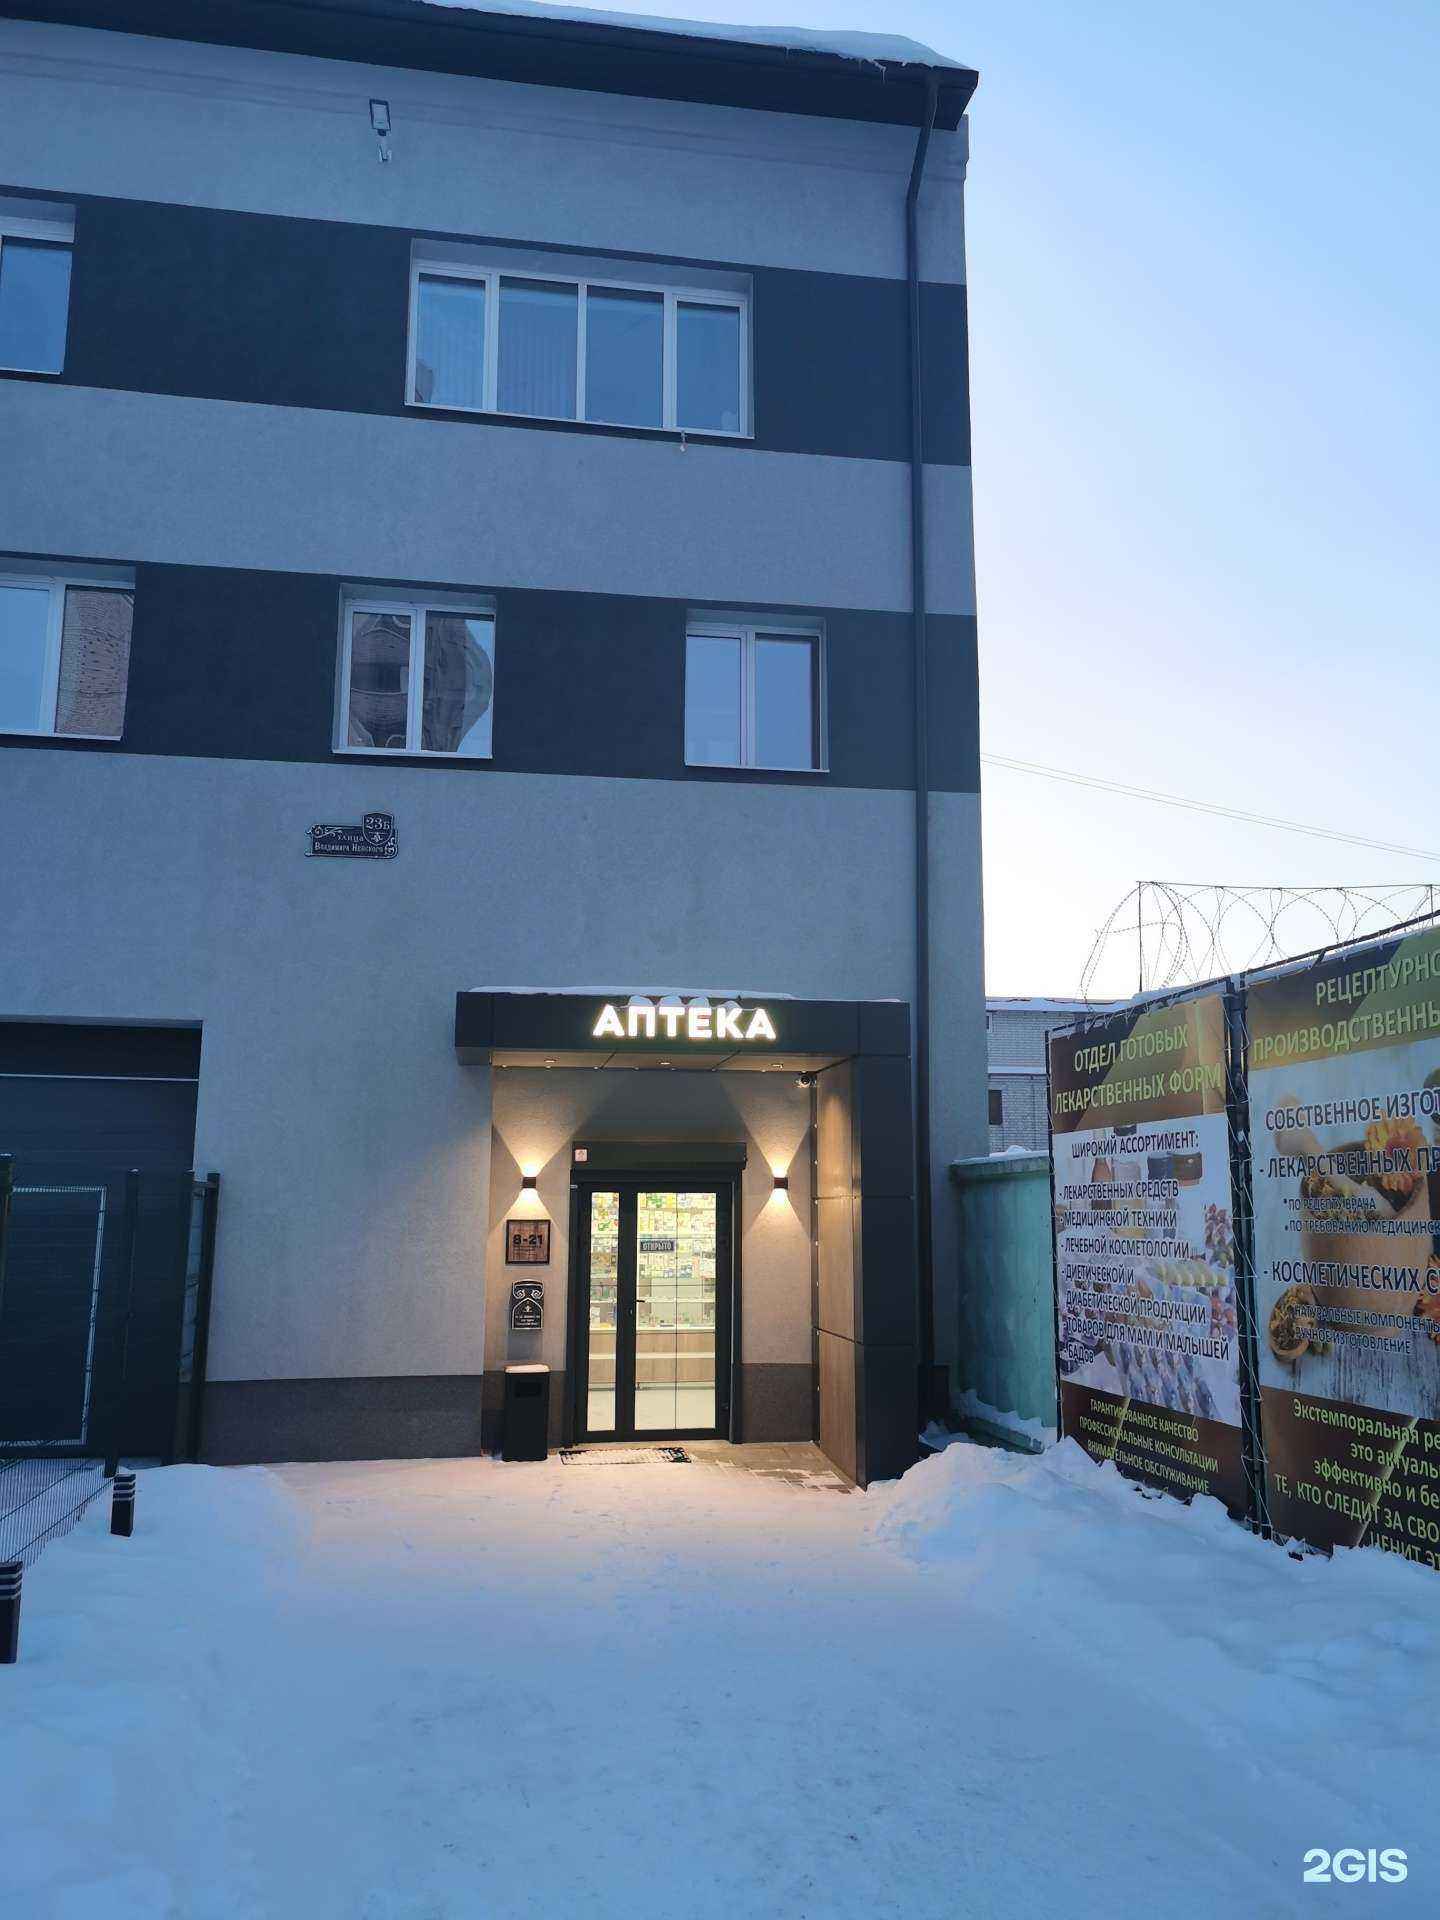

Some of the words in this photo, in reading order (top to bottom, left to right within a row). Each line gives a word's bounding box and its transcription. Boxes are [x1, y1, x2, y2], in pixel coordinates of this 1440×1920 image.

[592, 1004, 776, 1039] АПТЕКА
[1074, 1043, 1116, 1074] ОТДЕЛ
[1120, 1024, 1188, 1062] ГОТОВЫХ
[1055, 1073, 1165, 1114] ЛЕКАРСТВЕННЫХ
[1169, 1062, 1222, 1094] ФОРМ
[1266, 1097, 1382, 1131] СОБСТВЕННОЕ
[1072, 1137, 1117, 1158] ШИРОКИЙ
[1120, 1130, 1200, 1153] АССОРТИМЕНТ:
[1136, 1180, 1179, 1201] СРЕДСТВ
[1289, 1199, 1300, 1210] ПО
[1303, 1198, 1343, 1212] РЕЦЕПТУ
[1346, 1198, 1376, 1210] ВРАЧА
[1132, 1211, 1177, 1227] ТЕХНИКИ
[1290, 1221, 1302, 1232] ПО
[1304, 1221, 1370, 1232] ТРЕБОВАНИЮ
[513, 1234, 542, 1245] 8-21
[1128, 1270, 1134, 1282] И
[1066, 1290, 1136, 1314] ДИАБЕТИЧЕСКОЙ
[1140, 1300, 1206, 1324] ПРОДУКЦИИ
[1294, 1304, 1361, 1324] НАТУРАЛЬНЫЕ
[1106, 1323, 1125, 1342] ДЛЯ
[1128, 1328, 1152, 1345] МАМ
[1155, 1332, 1162, 1348] И
[1166, 1334, 1229, 1360] МАЛЫШЕЙ
[1296, 1328, 1331, 1342] РУЧНОЕ
[1334, 1330, 1410, 1354] ИЗГОТОВЛЕНИЕ
[1090, 1399, 1158, 1430] ГАРАНТИРОВАННОЕ
[1158, 1419, 1199, 1442] КАЧЕСТВО
[1293, 1398, 1419, 1445] Экстемпоральная
[1087, 1439, 1144, 1470] ВНИМАТЕЛЬНОЕ
[1144, 1461, 1210, 1494] ОБСЛУЖИВАНИЕ
[1154, 1438, 1219, 1473] КОНСУЛЬТАЦИИ
[1350, 1443, 1373, 1462] это
[1314, 1458, 1402, 1498] эффективно
[1406, 1486, 1416, 1502] и
[1274, 1474, 1292, 1499] ТЕ,
[1297, 1480, 1322, 1505] КТО
[1324, 1490, 1380, 1524] СЛЕДИТ
[1384, 1508, 1404, 1532] ЗА
